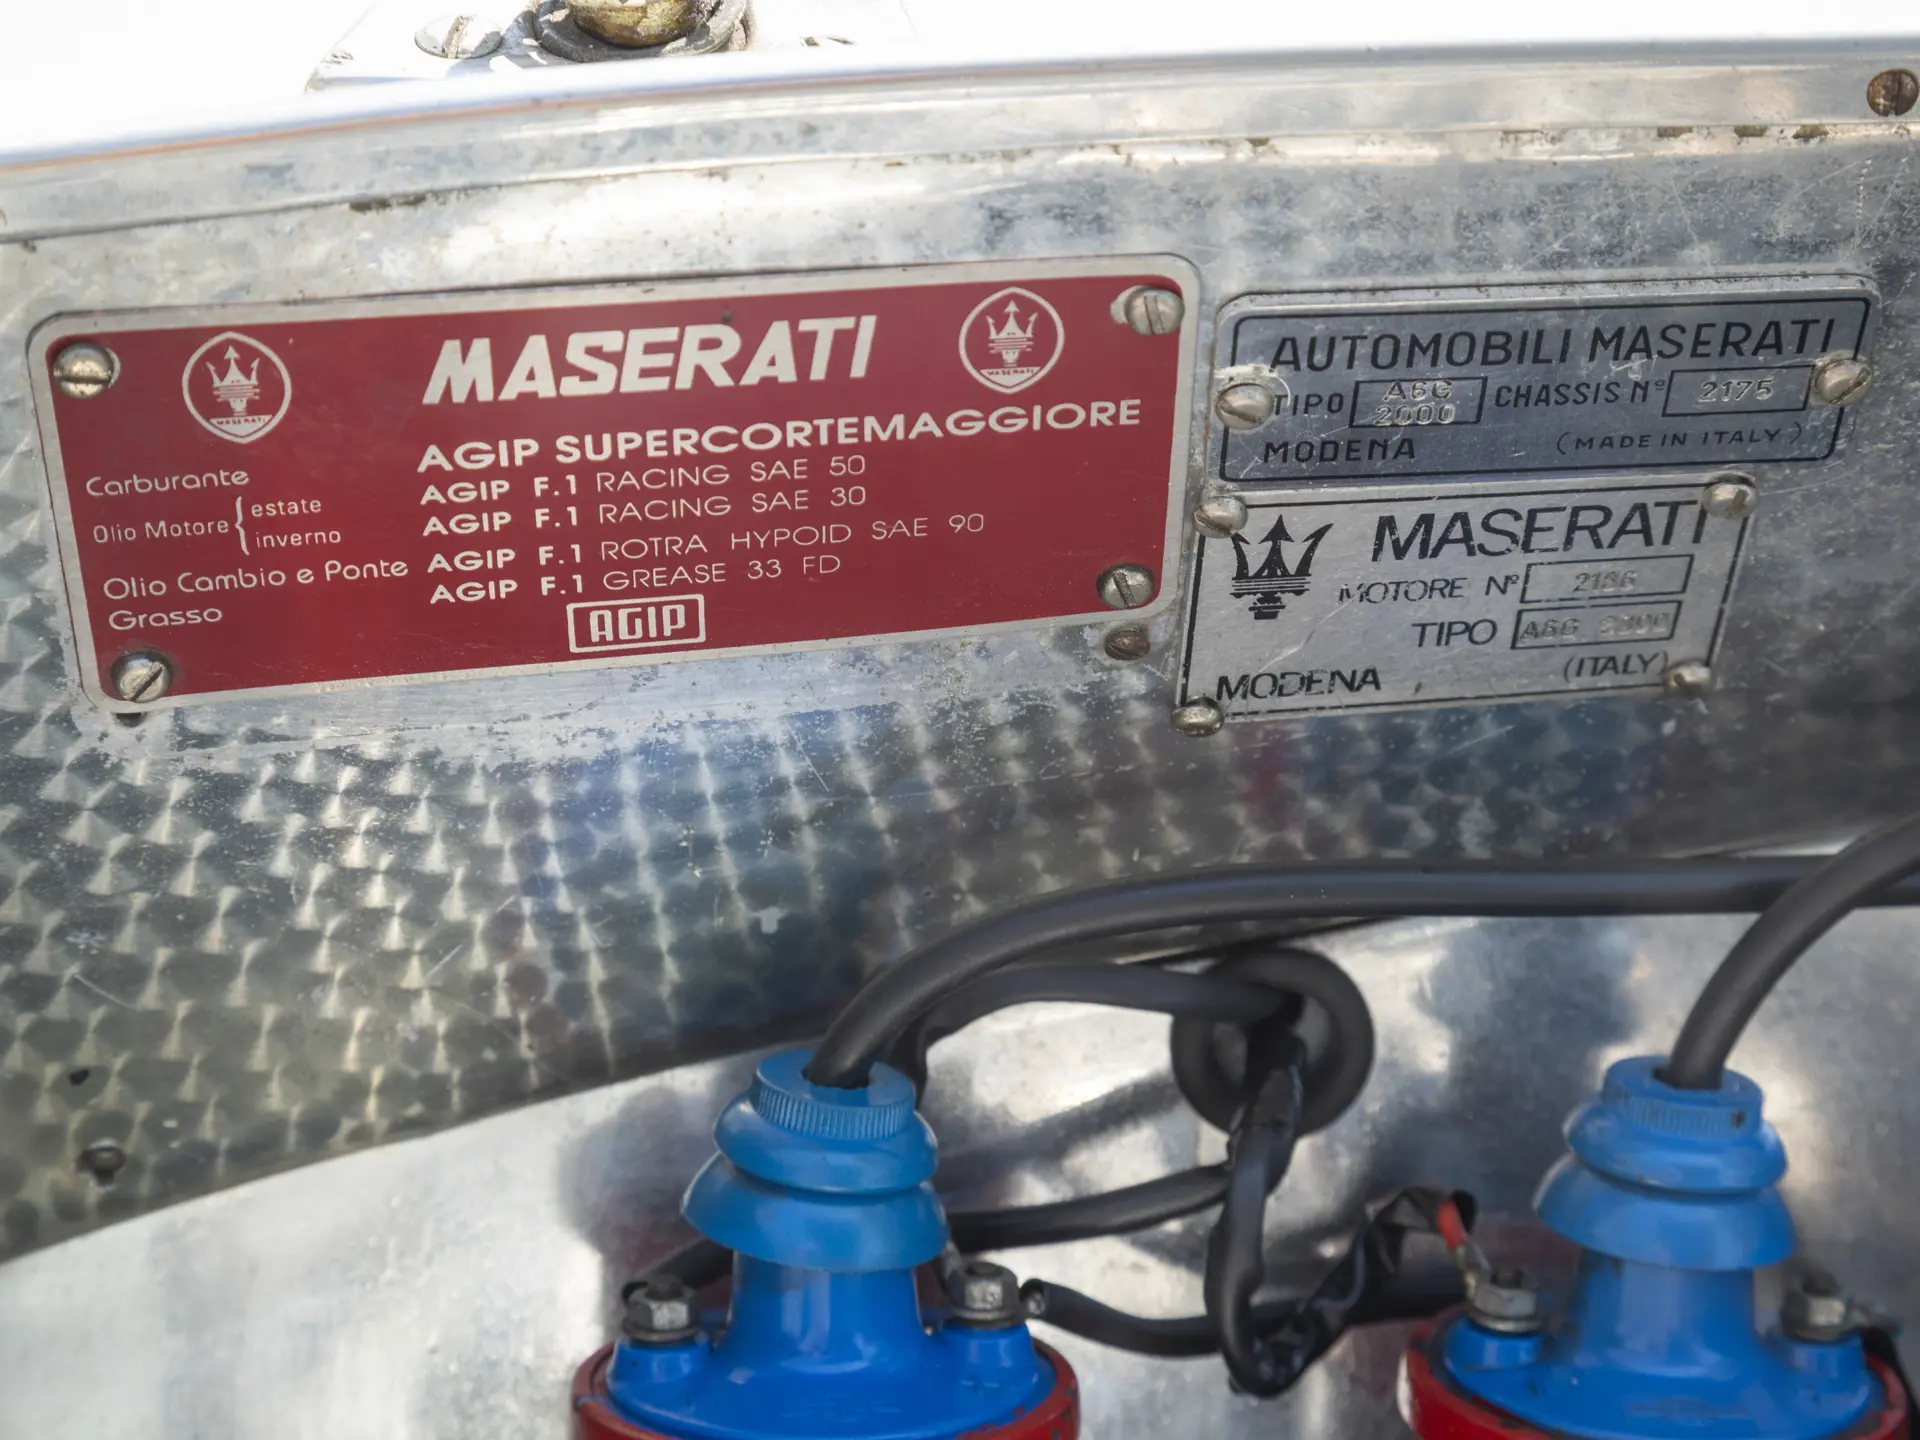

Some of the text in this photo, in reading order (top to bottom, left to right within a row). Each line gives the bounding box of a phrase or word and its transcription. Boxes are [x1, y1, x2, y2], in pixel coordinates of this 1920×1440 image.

[1270, 318, 1836, 372] AUTOMOBILI MASERATI
[422, 315, 877, 404] MASERATI
[1273, 392, 1344, 416] TIPO
[1382, 379, 1454, 402] A6G
[1494, 380, 1620, 408] CHASSIS
[1698, 377, 1775, 403] 2175
[216, 417, 266, 426] MASERATI
[1373, 403, 1456, 426] 2000
[417, 398, 1141, 473] AGIP SUPERCORTEMAGGIORE
[1556, 431, 1653, 455] (MADE
[1661, 432, 1687, 447] IN
[1262, 438, 1416, 464] MODENA
[86, 469, 250, 497] Carburante
[420, 455, 866, 505] AGIP F.1 RACING SAE 50
[250, 498, 323, 518] estate
[422, 486, 867, 537] AGIP F.1 RACING SAE 30
[93, 518, 230, 545] Olio Motore
[255, 529, 342, 549] inverno
[427, 512, 985, 573] AGIP F.1 ROTRA HYPOID SAE 90
[1371, 499, 1708, 562] MASERATI
[103, 559, 409, 600] Olio Cambio e Ponte
[430, 554, 841, 604] AGIP F.1 GREASE 33 FD
[1338, 577, 1469, 605] MOTORE
[108, 607, 223, 631] Grasso
[589, 604, 686, 643] AGIP
[1411, 618, 1498, 648] TIPO
[1215, 665, 1382, 702] MODENA
